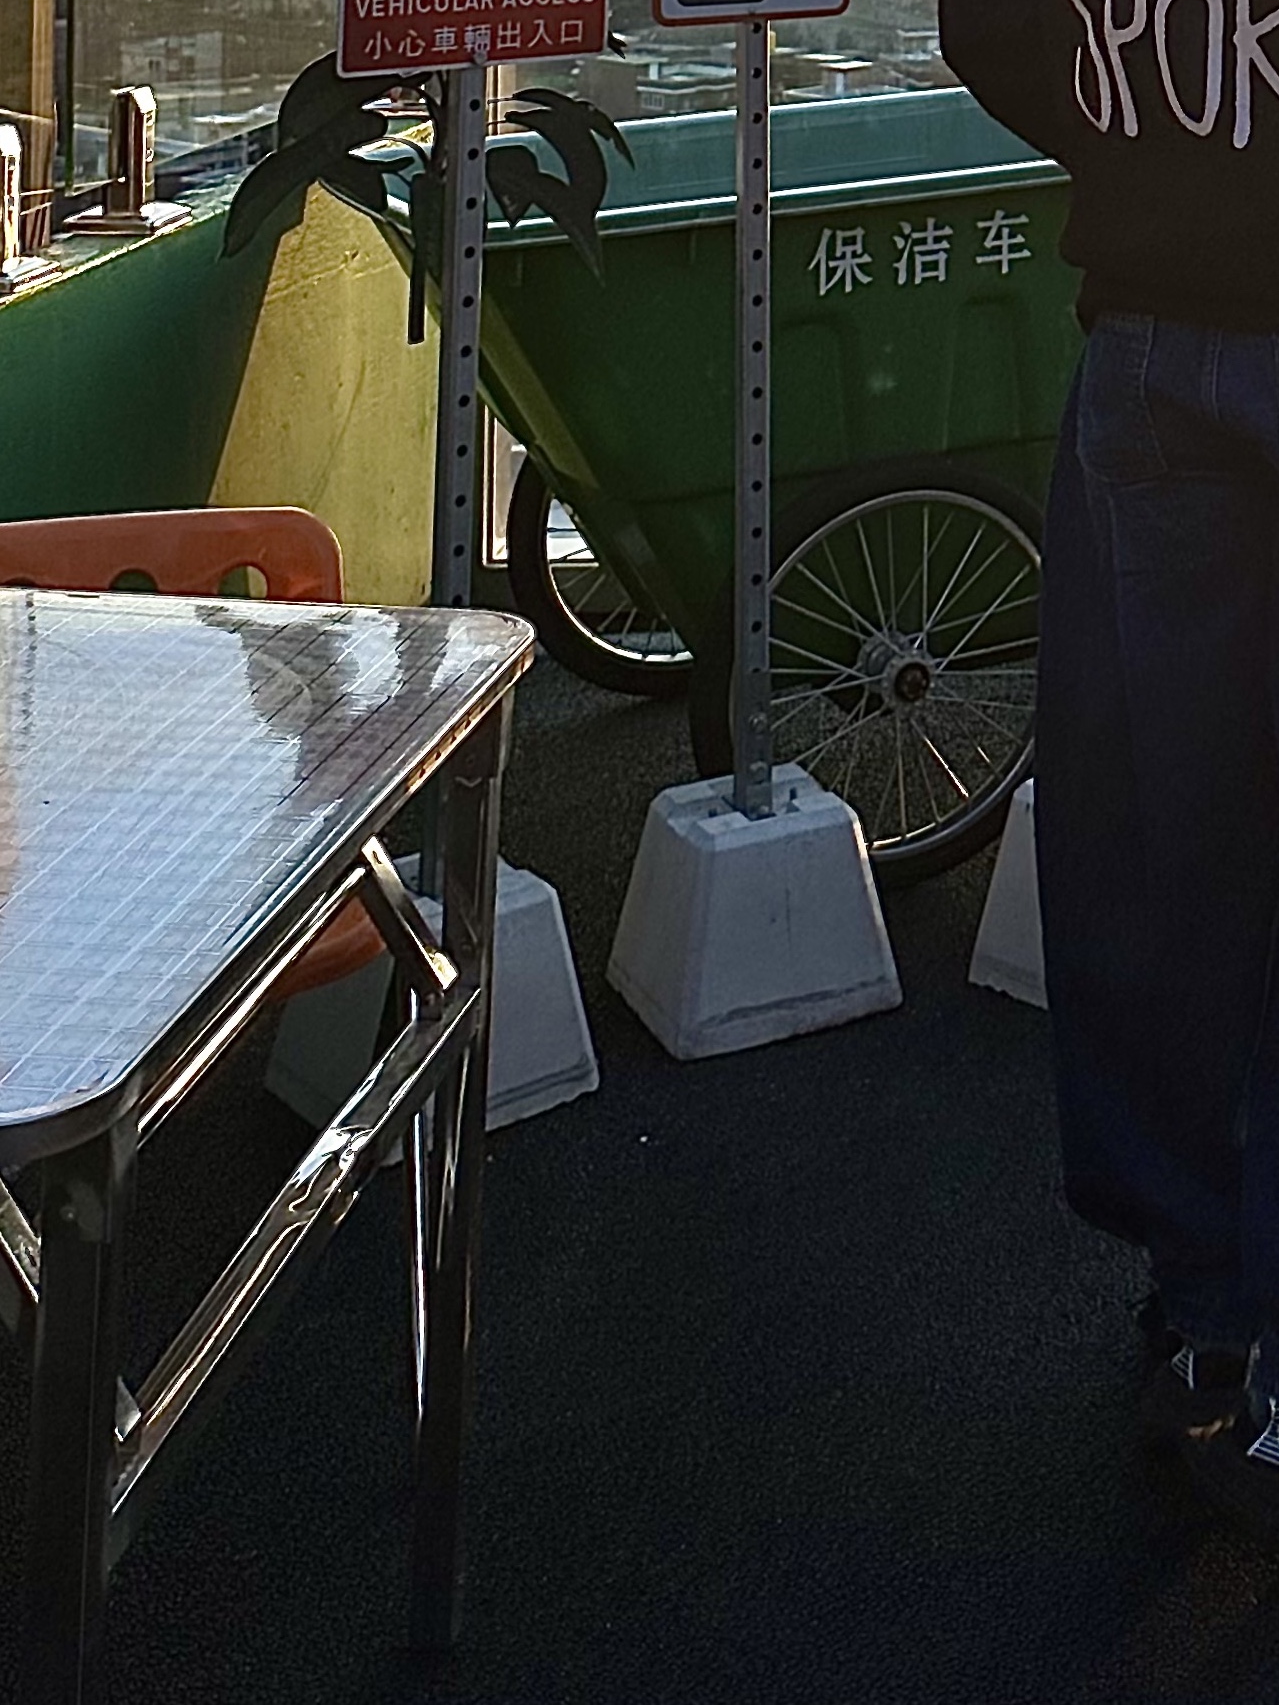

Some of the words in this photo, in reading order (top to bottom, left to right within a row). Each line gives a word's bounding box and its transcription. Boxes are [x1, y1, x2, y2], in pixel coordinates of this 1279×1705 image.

[364, 19, 584, 61] 小心車輛出入口
[807, 209, 1032, 296] 保洁车
